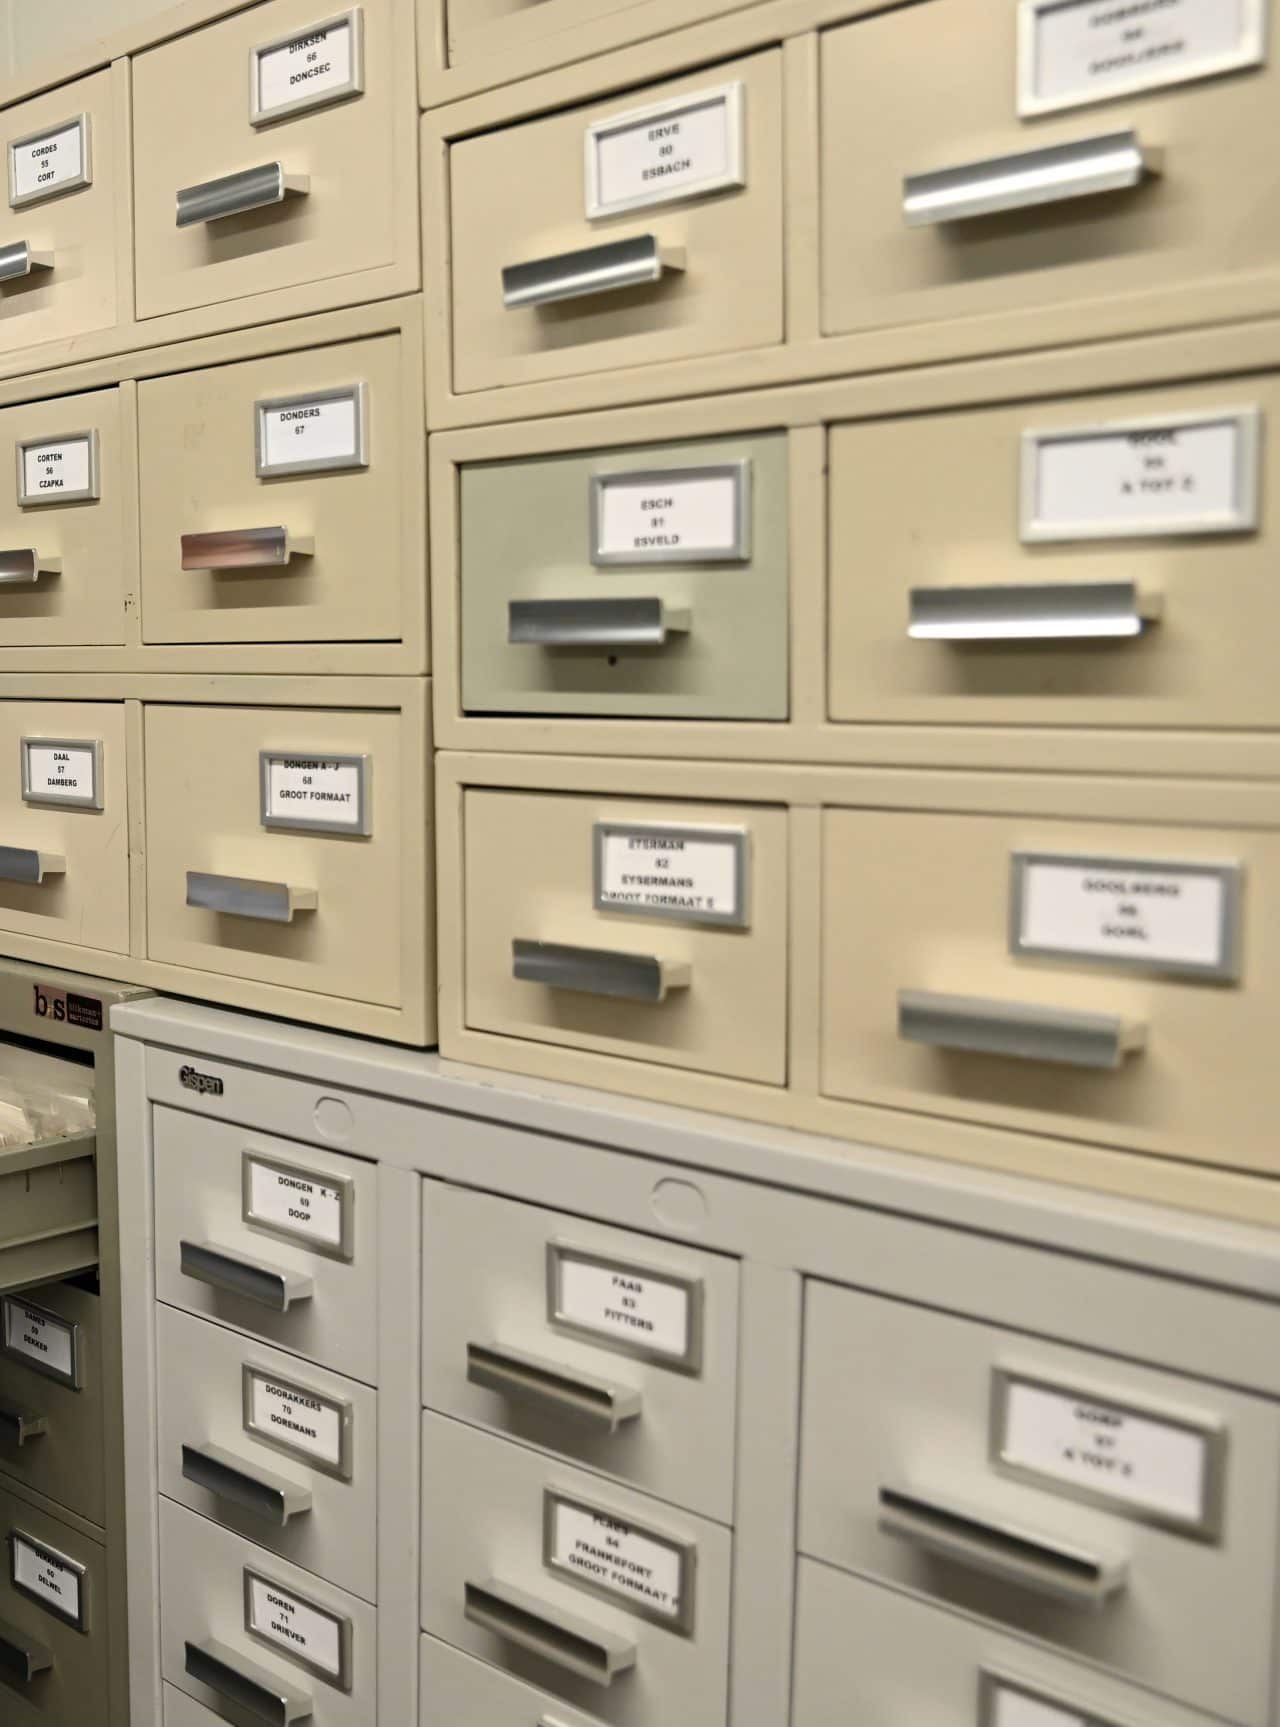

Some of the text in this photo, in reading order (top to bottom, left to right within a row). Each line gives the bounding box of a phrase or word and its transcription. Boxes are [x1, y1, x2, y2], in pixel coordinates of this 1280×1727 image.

[289, 31, 327, 54] DIRKSEN
[306, 52, 317, 63] 66
[289, 62, 331, 85] DONCSEC
[648, 124, 680, 141] ERVE
[31, 144, 58, 158] CORDES
[659, 144, 673, 157] 80
[41, 159, 49, 168] 55
[641, 159, 691, 180] ESBACH
[37, 171, 55, 183] CORT
[280, 408, 320, 422] DONDERS
[294, 426, 305, 435] 67
[37, 453, 62, 463] CORTEN
[46, 467, 53, 475] 56
[39, 479, 64, 488] CZAPKA
[640, 498, 672, 511] ESCH
[633, 535, 680, 547] ESVELD
[53, 753, 70, 761] DAAL
[284, 760, 318, 770] DONGEN
[47, 778, 78, 787] DAMBERG
[302, 776, 312, 785] 68
[279, 790, 351, 802] GROOT FORMAAT
[621, 874, 693, 887] EYSERMANS
[179, 1065, 224, 1095] Gispen
[278, 1176, 313, 1193] DONGEN
[300, 1197, 310, 1208] 69
[288, 1208, 311, 1221] DOOP
[604, 1308, 654, 1332] FITTERS
[23, 1334, 48, 1353] DEKKER
[265, 1384, 322, 1412] DOORAKKERS
[282, 1404, 292, 1415] 70
[271, 1414, 317, 1438] DOREMANS
[568, 1554, 608, 1577] GROOT
[611, 1571, 668, 1601] FORMAAT
[267, 1593, 295, 1615] DOREN
[279, 1612, 289, 1624] 71
[271, 1621, 306, 1645] DRIEVER
